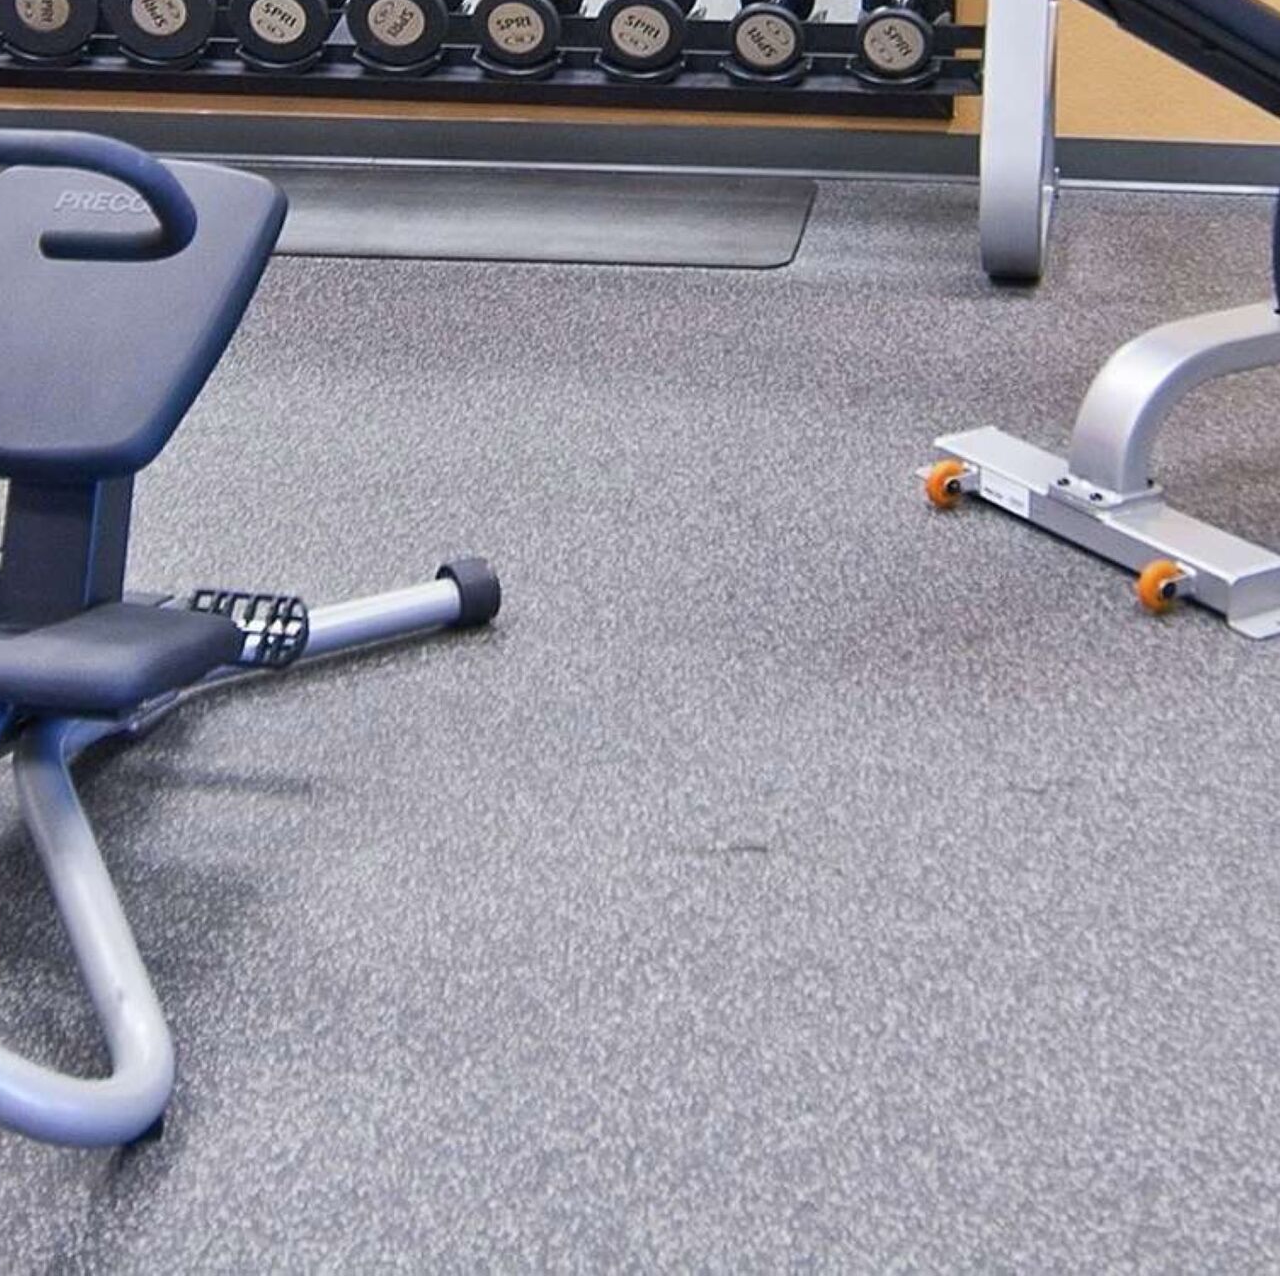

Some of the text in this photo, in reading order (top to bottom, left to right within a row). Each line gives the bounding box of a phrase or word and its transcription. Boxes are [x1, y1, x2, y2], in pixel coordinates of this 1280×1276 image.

[261, 1, 297, 28] SPRI
[495, 15, 531, 31] SPRI
[626, 14, 661, 39] SPRI
[746, 26, 778, 59] SPRI
[882, 24, 913, 57] SPRI
[53, 190, 152, 213] PRECO
